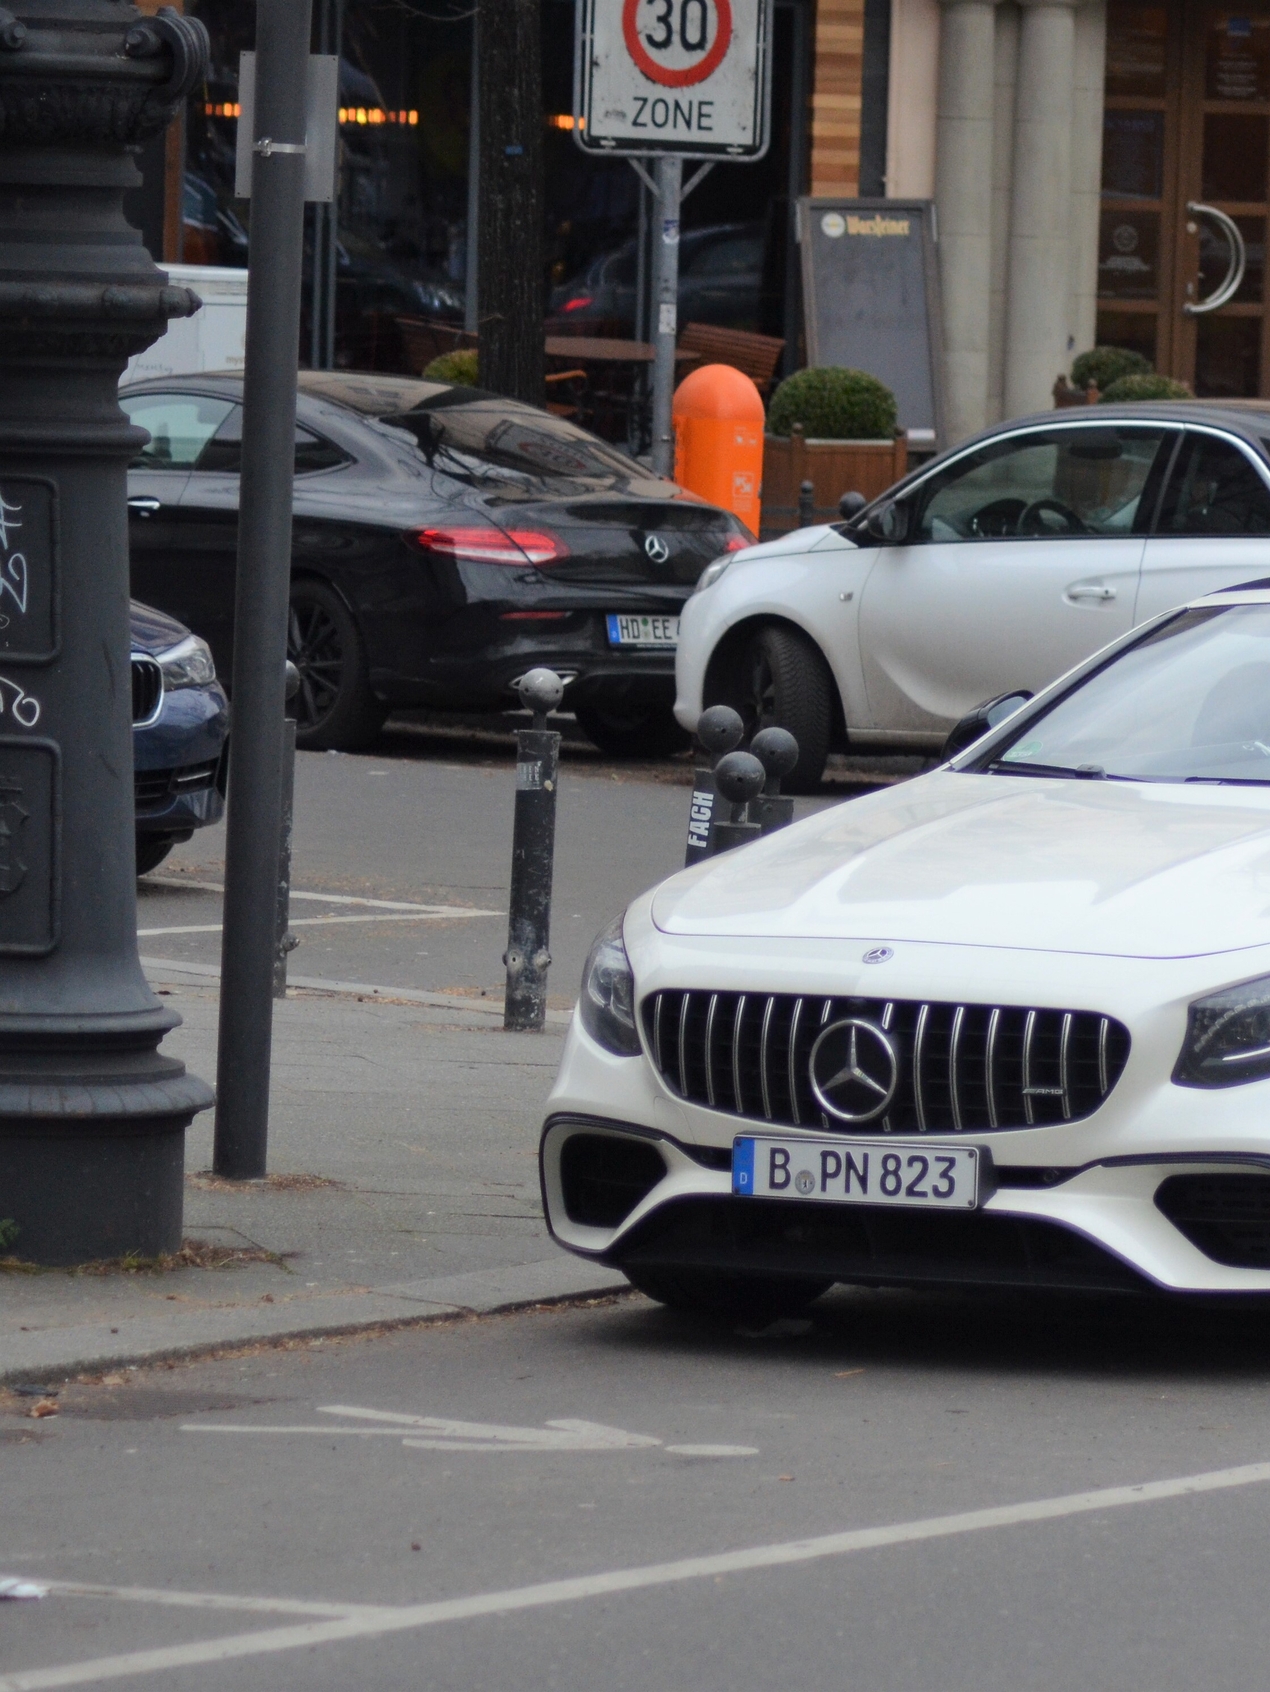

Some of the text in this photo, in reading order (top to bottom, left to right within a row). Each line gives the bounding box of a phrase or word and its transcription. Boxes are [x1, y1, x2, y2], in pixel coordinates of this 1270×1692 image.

[645, 0, 708, 51] 30
[631, 96, 714, 131] ZONE
[620, 618, 641, 639] HD
[687, 790, 714, 848] FACH
[768, 1147, 957, 1199] B PN 823
